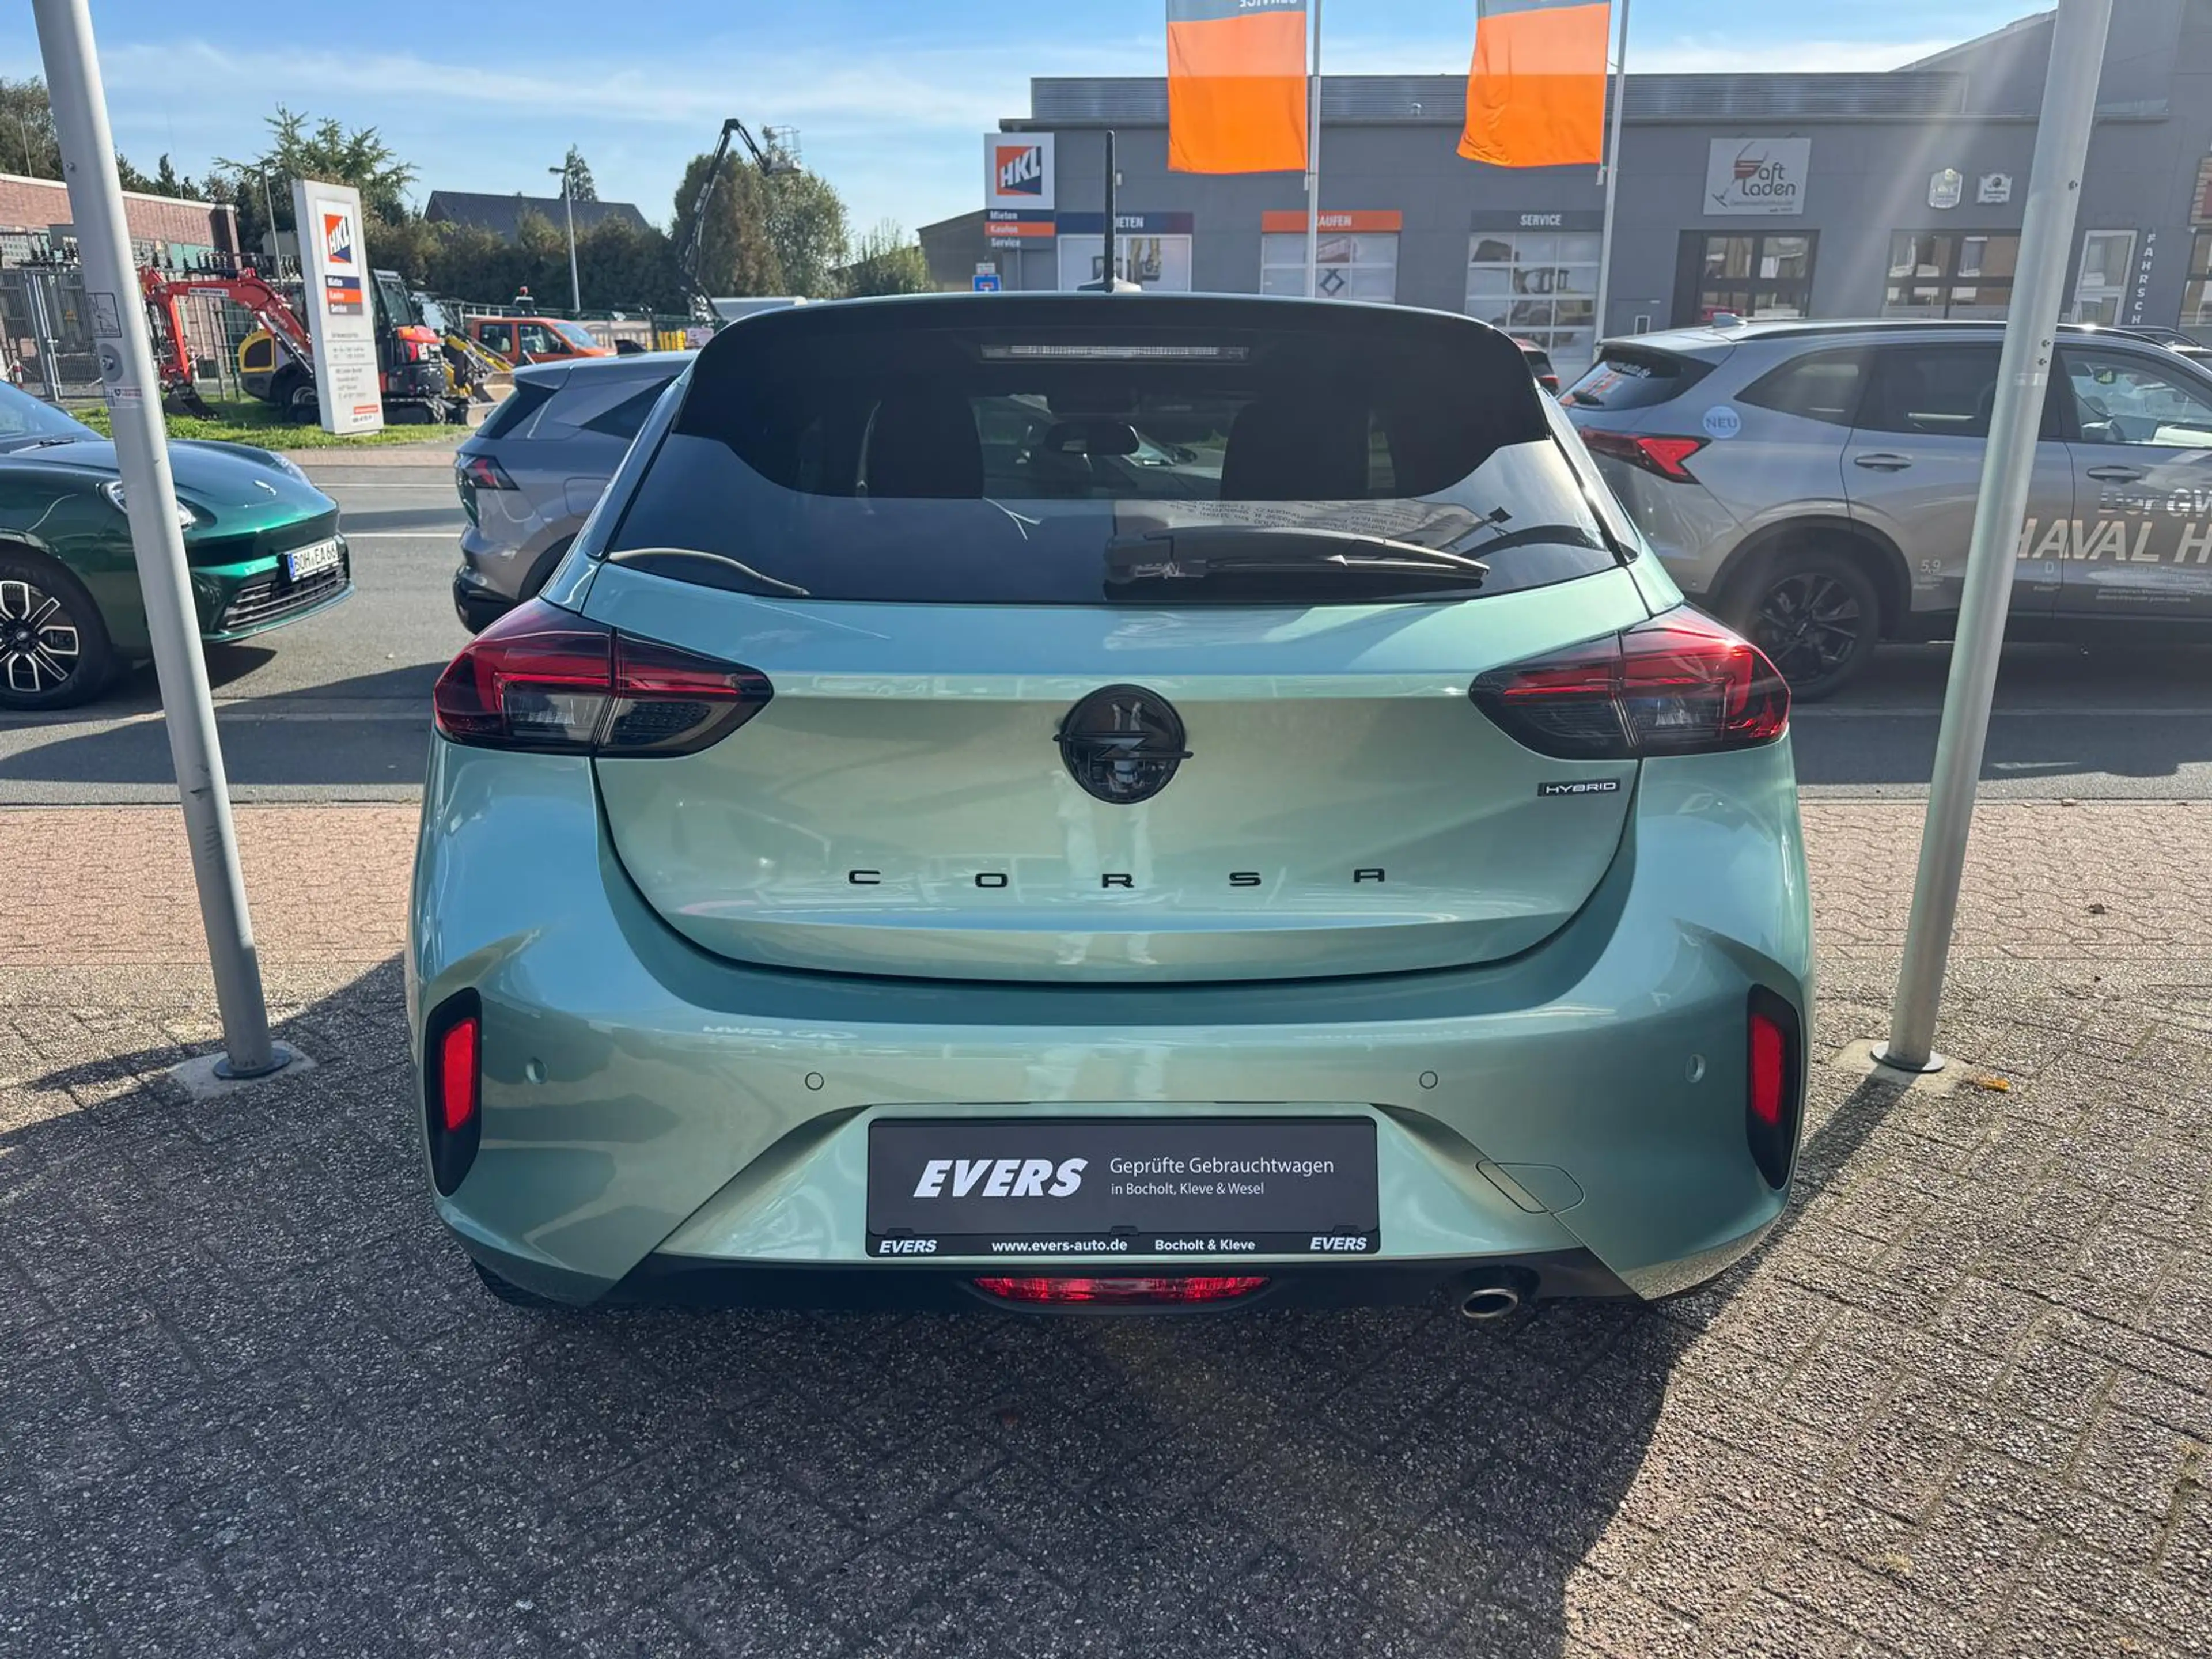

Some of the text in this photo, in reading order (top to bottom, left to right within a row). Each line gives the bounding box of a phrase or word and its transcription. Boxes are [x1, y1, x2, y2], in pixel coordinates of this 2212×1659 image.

[1001, 147, 1040, 188] HKL
[1742, 179, 1796, 196] Laden
[1520, 215, 1561, 226] SERVICE
[329, 217, 349, 255] HKL
[2131, 233, 2156, 324] FAHRSCH
[1706, 416, 1738, 429] NEU
[1546, 782, 1617, 794] HYBRID
[848, 868, 1385, 889] CORSA
[1109, 1157, 1334, 1177] Geprüfte Gebrauchtwagen
[913, 1158, 1088, 1198] EVERS
[1111, 1183, 1264, 1196] in Bocholt, Kleve & Wesel
[879, 1240, 938, 1254] EVERS
[991, 1239, 1128, 1252] www.evers-auto.de
[1155, 1239, 1256, 1251] Bocholt & Kleve
[1309, 1237, 1368, 1251] EVERS
